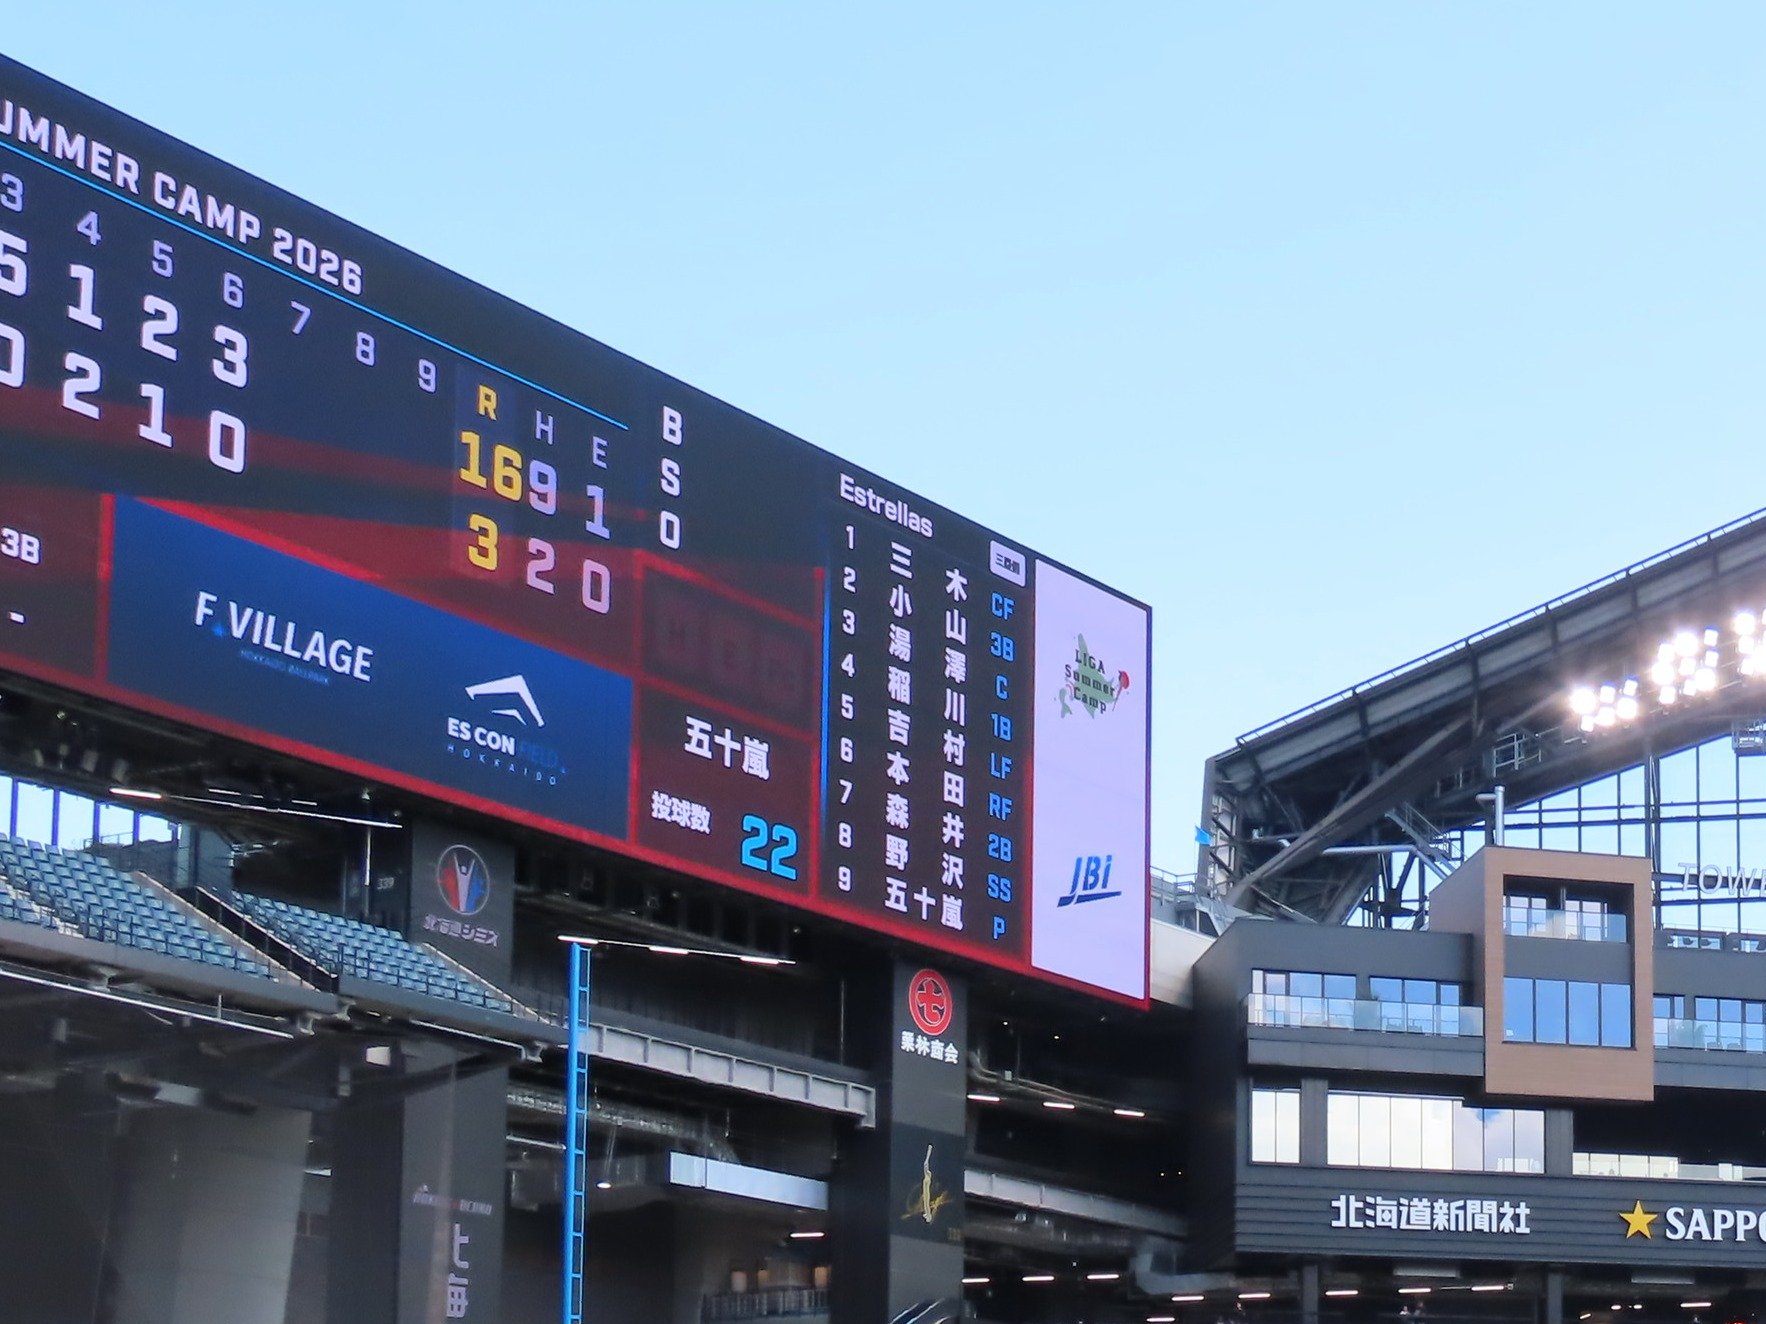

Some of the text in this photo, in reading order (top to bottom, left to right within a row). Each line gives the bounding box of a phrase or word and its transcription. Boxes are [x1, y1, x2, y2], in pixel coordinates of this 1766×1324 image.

[154, 171, 260, 243] CAMP
[273, 227, 363, 296] 2026
[1, 172, 608, 469] 3 4 5 6 7 8 9 R H E
[67, 263, 102, 331] 1
[141, 294, 178, 361] 2
[212, 324, 248, 389] 3
[460, 430, 523, 501] 16
[529, 459, 557, 516] 9
[585, 484, 611, 540] 1
[663, 405, 683, 446] B
[62, 351, 101, 420] 2
[138, 382, 173, 448] 1
[209, 409, 247, 473] 0
[468, 513, 498, 572] 3
[526, 537, 555, 595] 2
[582, 558, 610, 615] 0
[661, 457, 681, 497] S
[840, 472, 934, 538] Estrellas
[1, 524, 41, 565] 3B
[845, 525, 855, 550] 1
[991, 592, 1015, 620] CF
[195, 591, 217, 626] F
[229, 600, 374, 682] VILLAGE
[842, 609, 855, 635] 3
[995, 675, 1008, 700] C
[843, 566, 857, 593] 2
[990, 631, 1014, 662] 3B
[841, 653, 855, 677] 4
[990, 713, 1012, 741] 1B
[1065, 664, 1115, 697] Summer
[1074, 687, 1106, 714] Camp
[1075, 649, 1105, 674] LIGA
[684, 715, 769, 780] 五十嵐
[841, 693, 854, 719] 5
[990, 752, 1012, 779] LF
[840, 737, 854, 763] 6
[989, 792, 1012, 820] RF
[741, 814, 797, 881] 22
[839, 779, 852, 804] 7
[988, 833, 1012, 862] 2B
[838, 822, 852, 848] 8
[987, 873, 1011, 902] SS
[838, 866, 851, 892] 9
[993, 916, 1006, 940] P
[1331, 1194, 1531, 1235] 北海道新聞社
